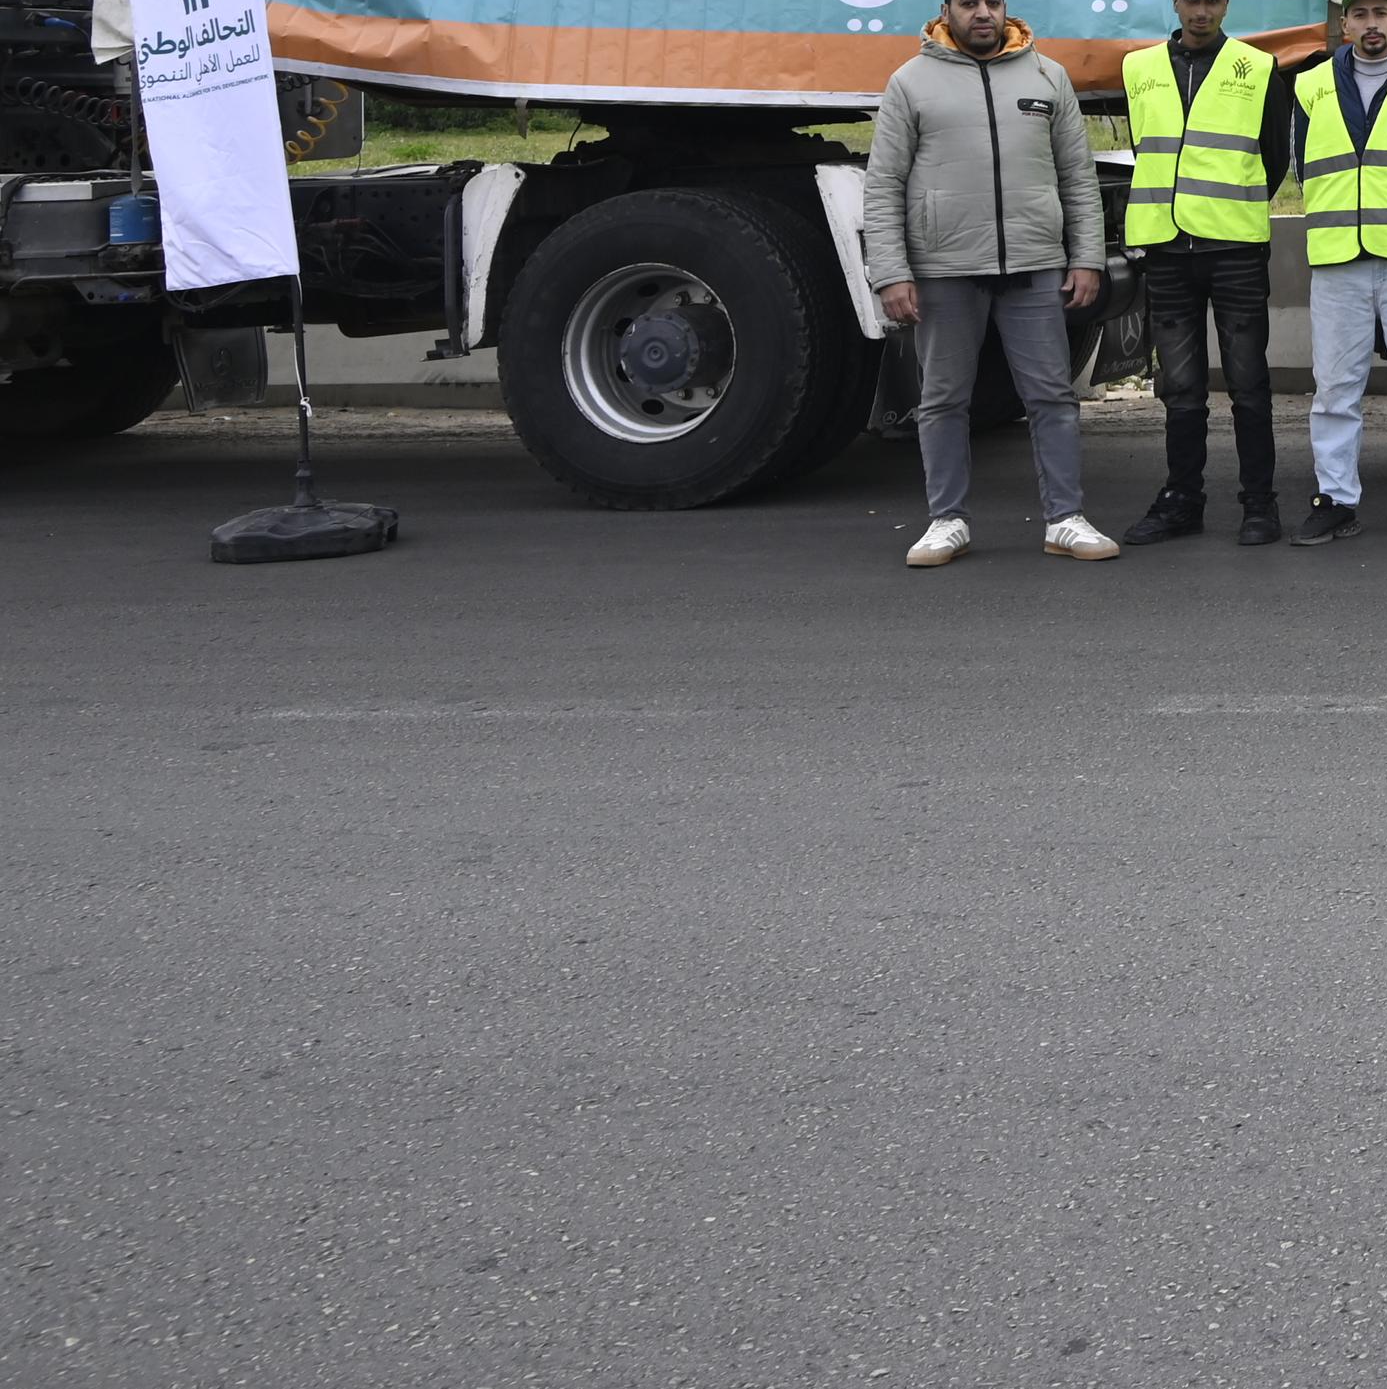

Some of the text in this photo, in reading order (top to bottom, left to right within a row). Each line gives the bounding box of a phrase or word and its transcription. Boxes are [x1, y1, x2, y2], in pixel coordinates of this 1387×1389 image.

[138, 9, 256, 70] التحالف الوطني
[140, 43, 260, 92] للعمل الأهلي التنموي
